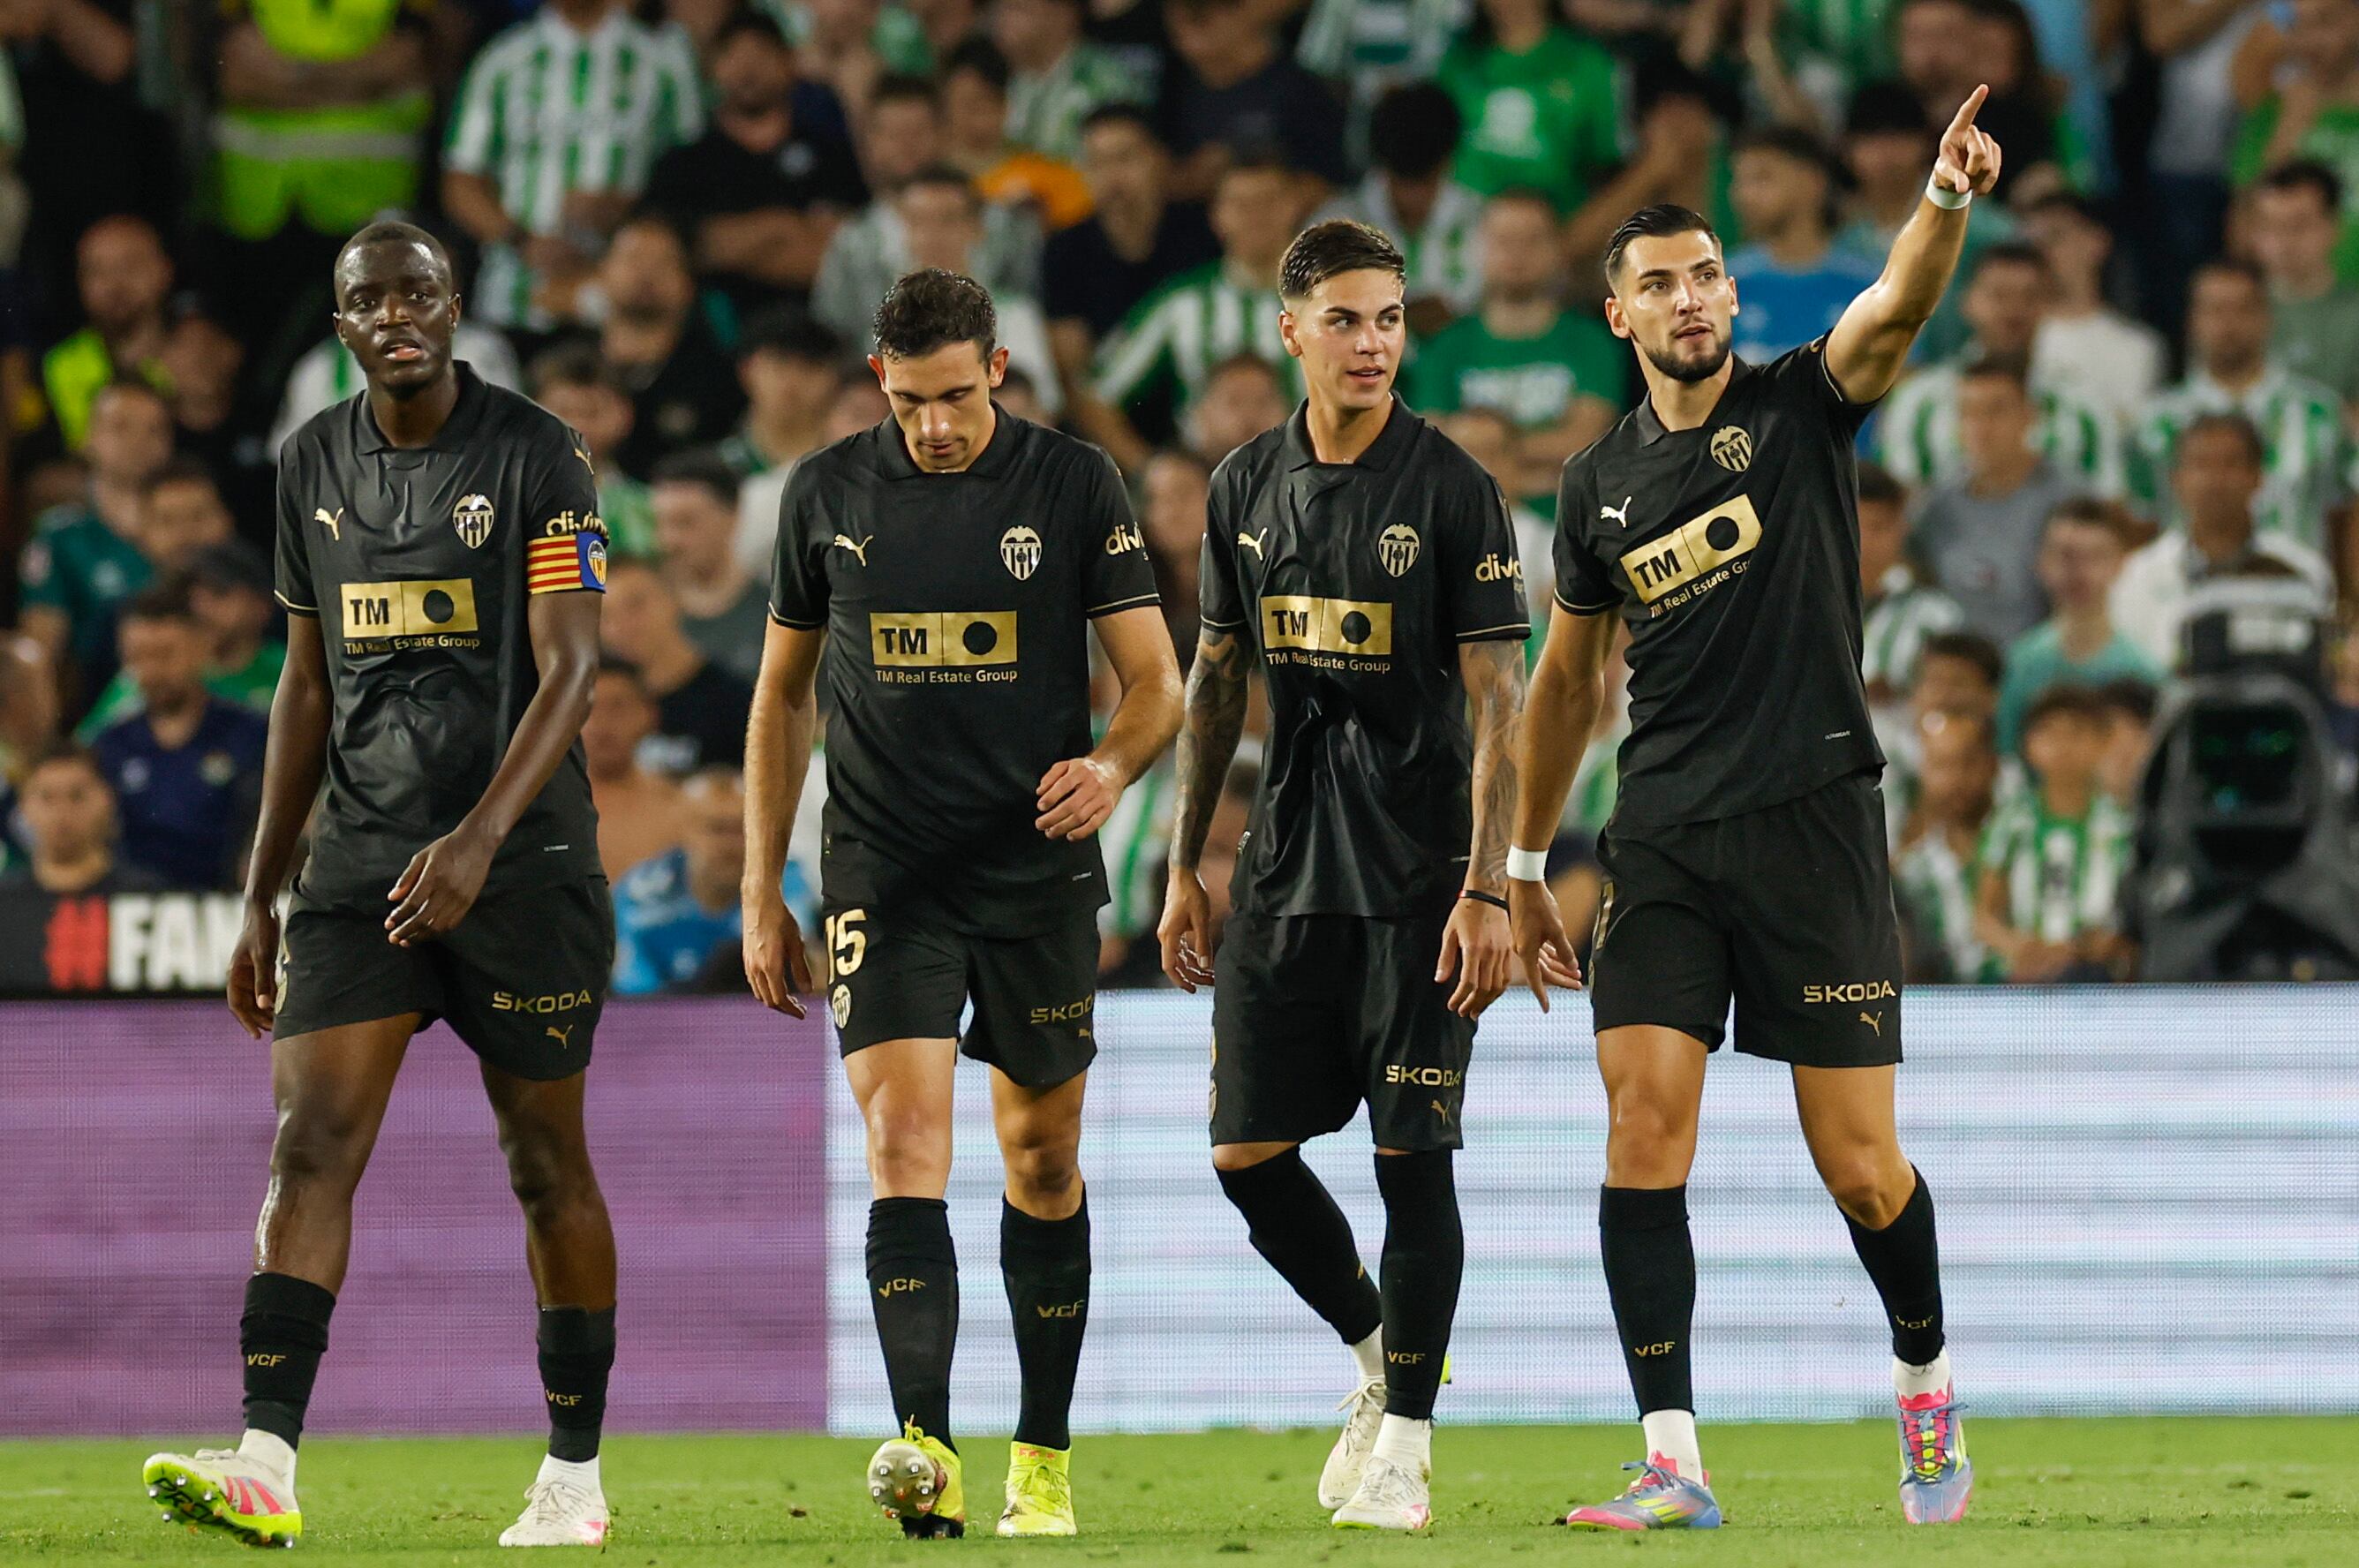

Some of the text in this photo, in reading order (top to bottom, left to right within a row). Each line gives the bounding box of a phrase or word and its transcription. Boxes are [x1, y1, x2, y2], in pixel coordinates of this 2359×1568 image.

[1633, 547, 1682, 589] TM
[1663, 587, 1692, 610] Real
[1692, 570, 1730, 596] Estate
[350, 598, 390, 625] TM
[1271, 610, 1308, 637] TM
[344, 642, 365, 655] TM
[438, 634, 480, 650] Group
[879, 628, 927, 655] TM
[1266, 652, 1288, 666] TM
[1349, 659, 1391, 674] Group
[876, 669, 1018, 684] TM Real Estate Group
[1030, 993, 1093, 1024] SKOD
[878, 1278, 926, 1299] VCF
[1036, 1299, 1086, 1318] VCF
[1387, 1350, 1426, 1365] VCF
[1634, 1340, 1676, 1358] VCF
[247, 1353, 287, 1368] VCF
[545, 1389, 583, 1406] VCF
